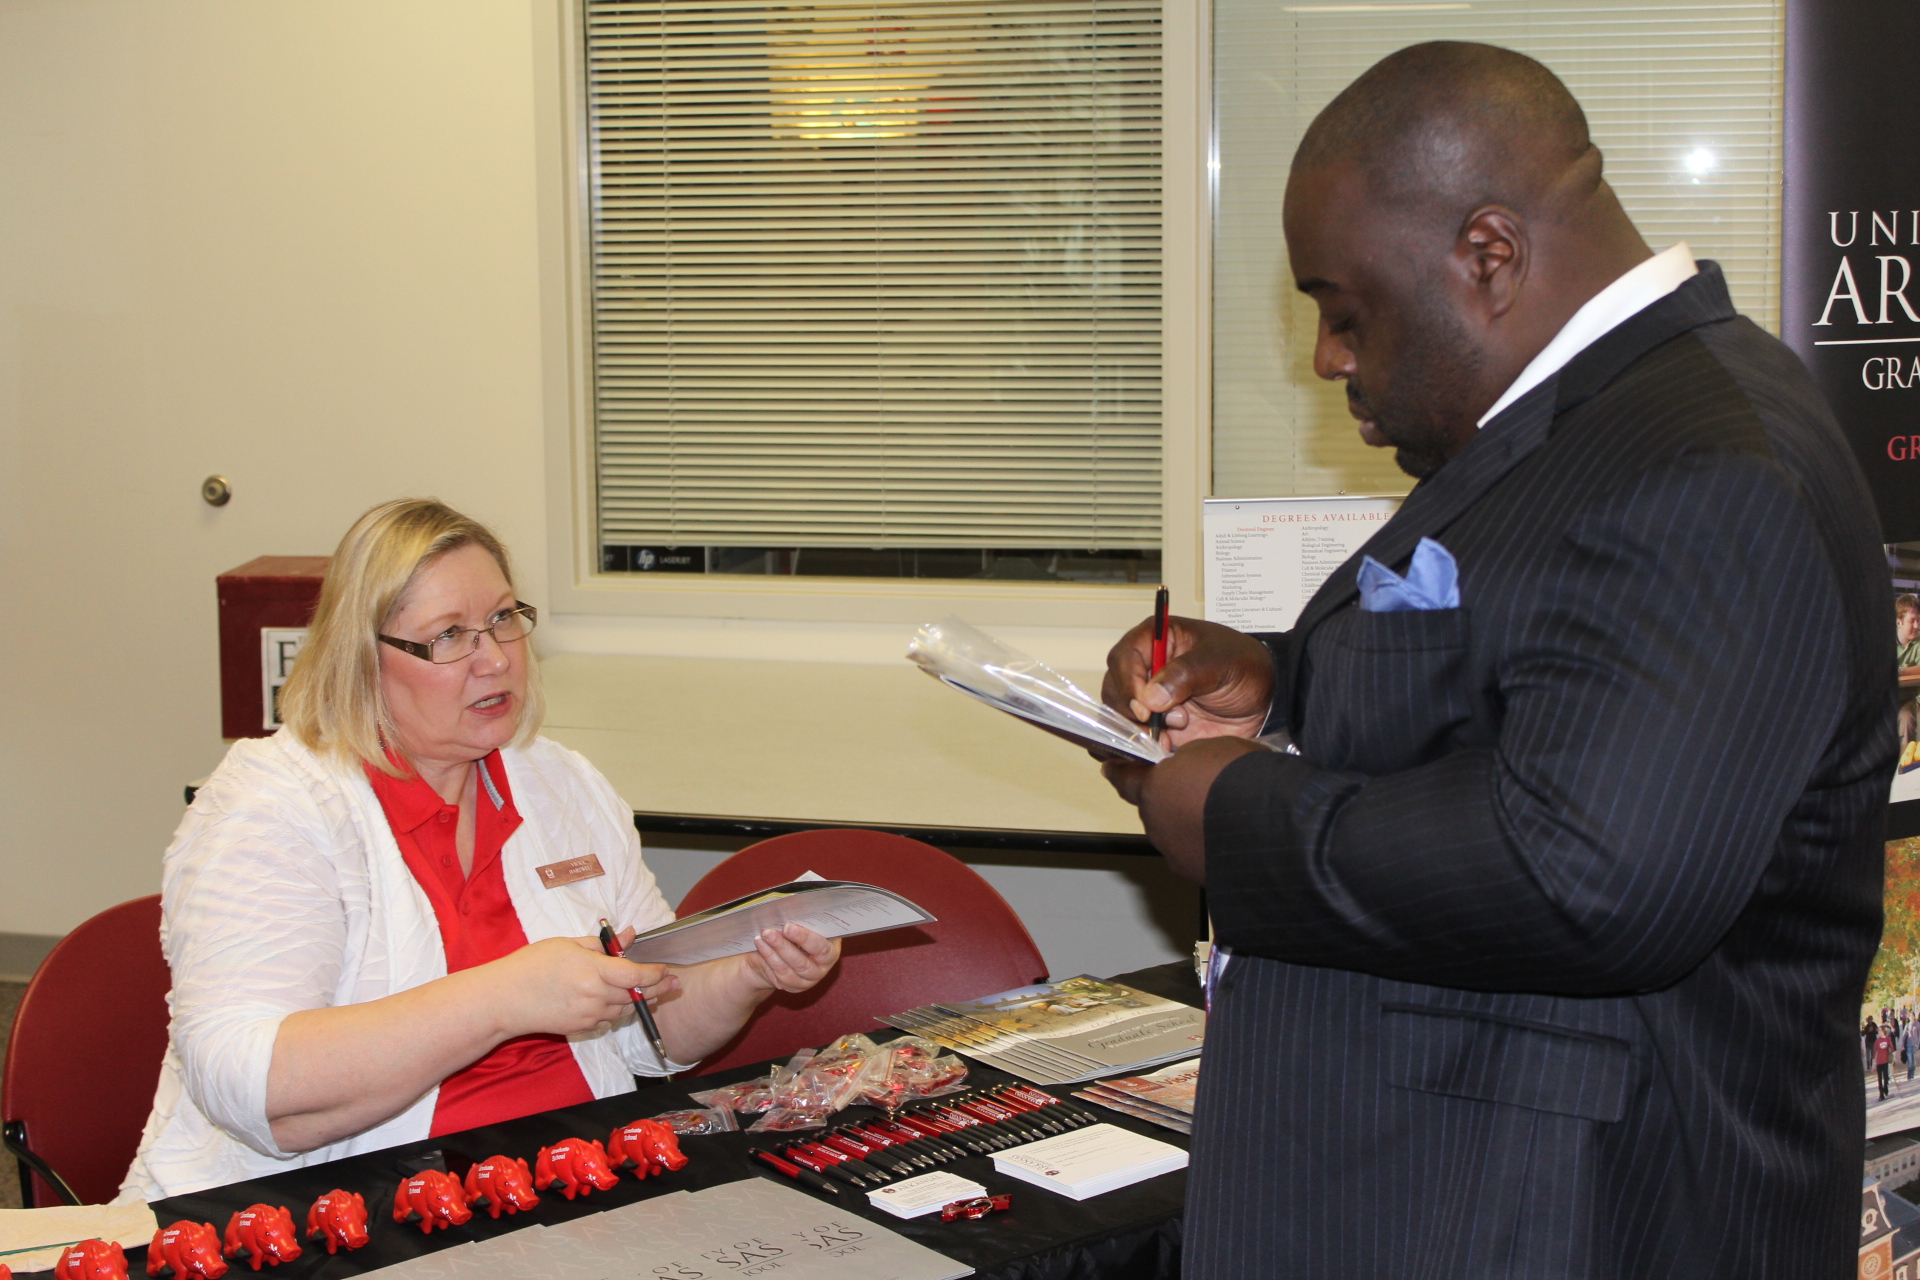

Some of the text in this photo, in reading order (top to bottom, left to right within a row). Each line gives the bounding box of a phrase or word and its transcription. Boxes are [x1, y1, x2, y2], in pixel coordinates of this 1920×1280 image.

[1262, 512, 1390, 523] DEGREES AVAILABLE
[640, 550, 655, 569] hp
[1088, 1014, 1196, 1050] Graduate School
[1155, 1070, 1199, 1084] Visito
[552, 1153, 566, 1161] School
[734, 1238, 762, 1249] OF
[652, 1261, 682, 1274] OF
